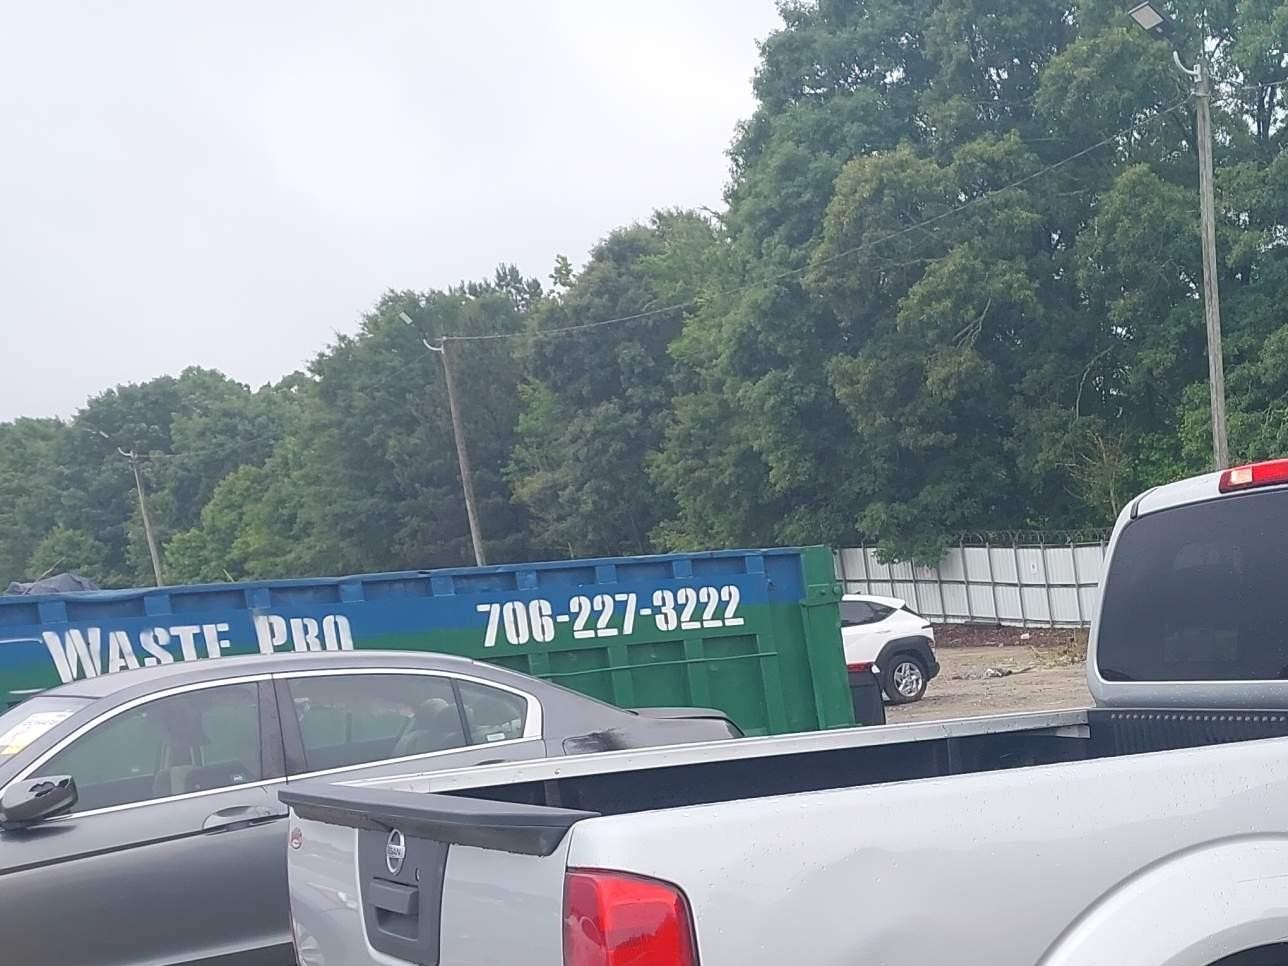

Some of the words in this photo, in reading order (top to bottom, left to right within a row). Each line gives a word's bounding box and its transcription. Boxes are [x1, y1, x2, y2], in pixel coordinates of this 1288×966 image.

[42, 623, 230, 684] WASTE
[253, 614, 354, 655] PRO
[476, 584, 745, 648] 706-227-3222
